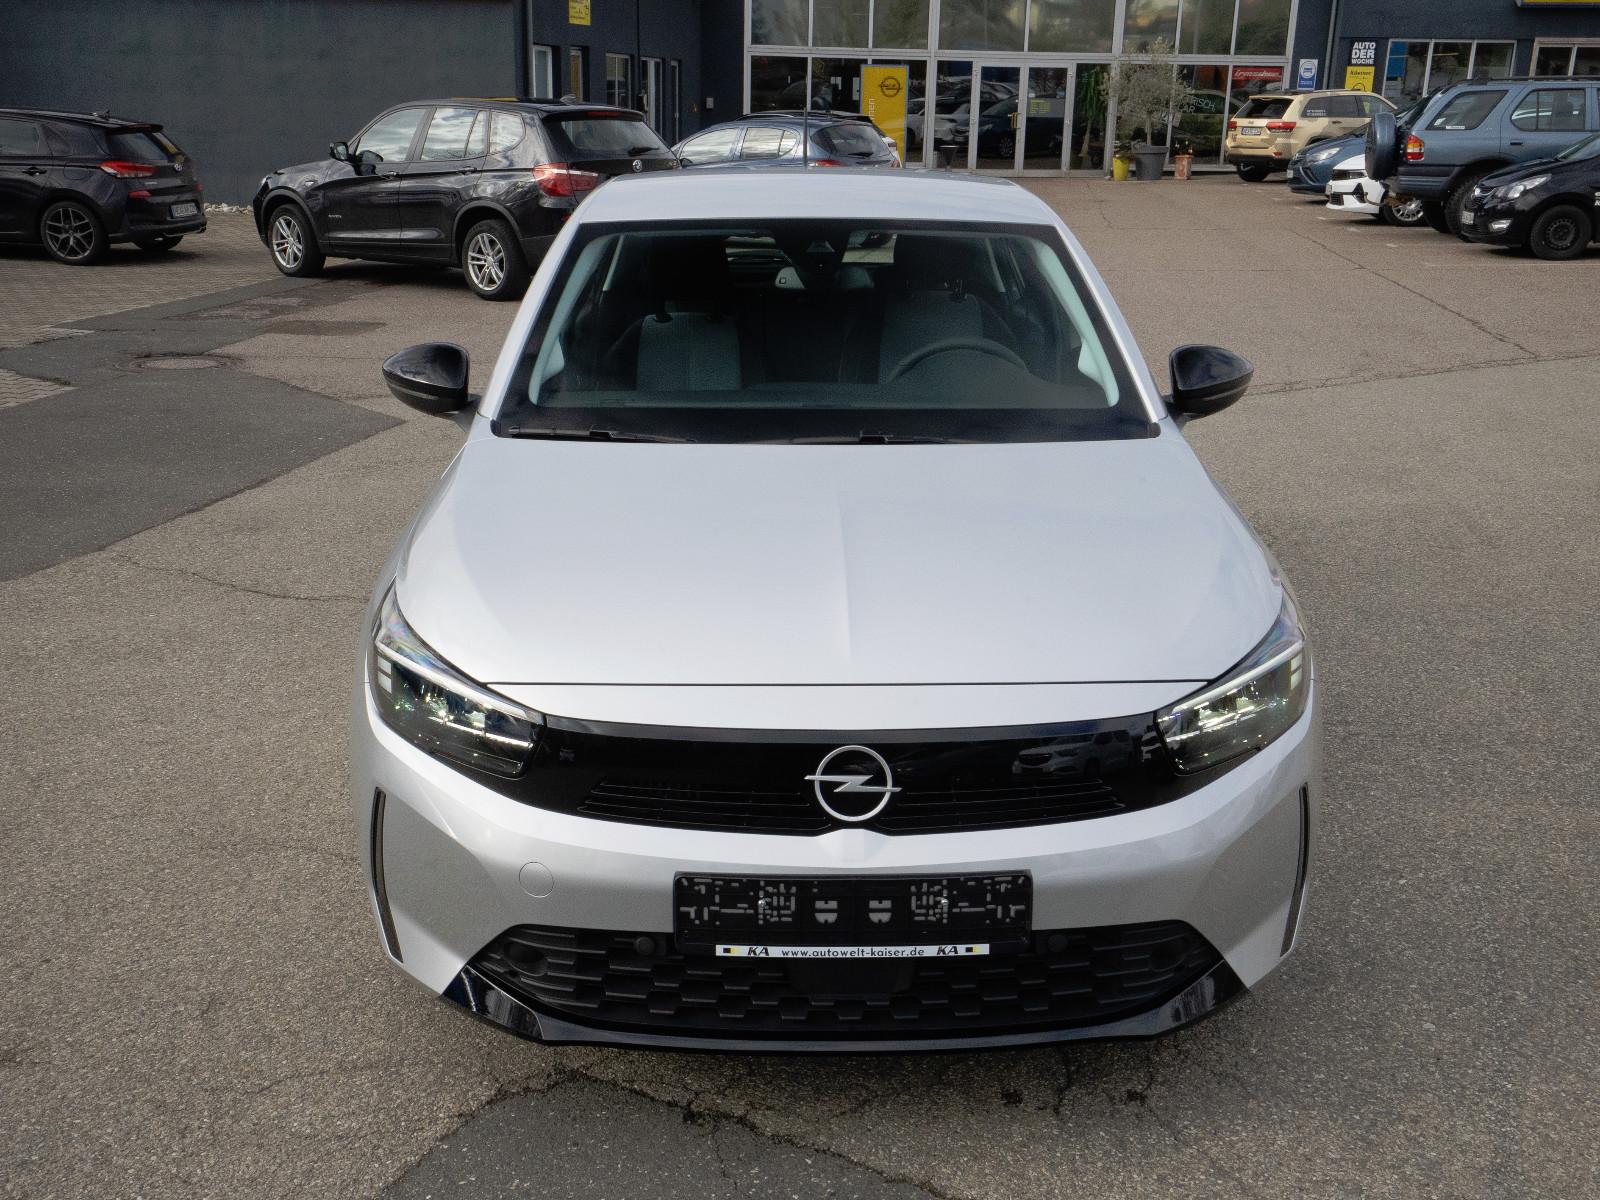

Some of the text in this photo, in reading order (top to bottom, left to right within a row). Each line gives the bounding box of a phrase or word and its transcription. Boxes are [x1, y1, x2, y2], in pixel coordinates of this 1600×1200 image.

[1352, 50, 1375, 59] DER
[747, 945, 959, 957] KA www.autowelt-kaiser.de KA
